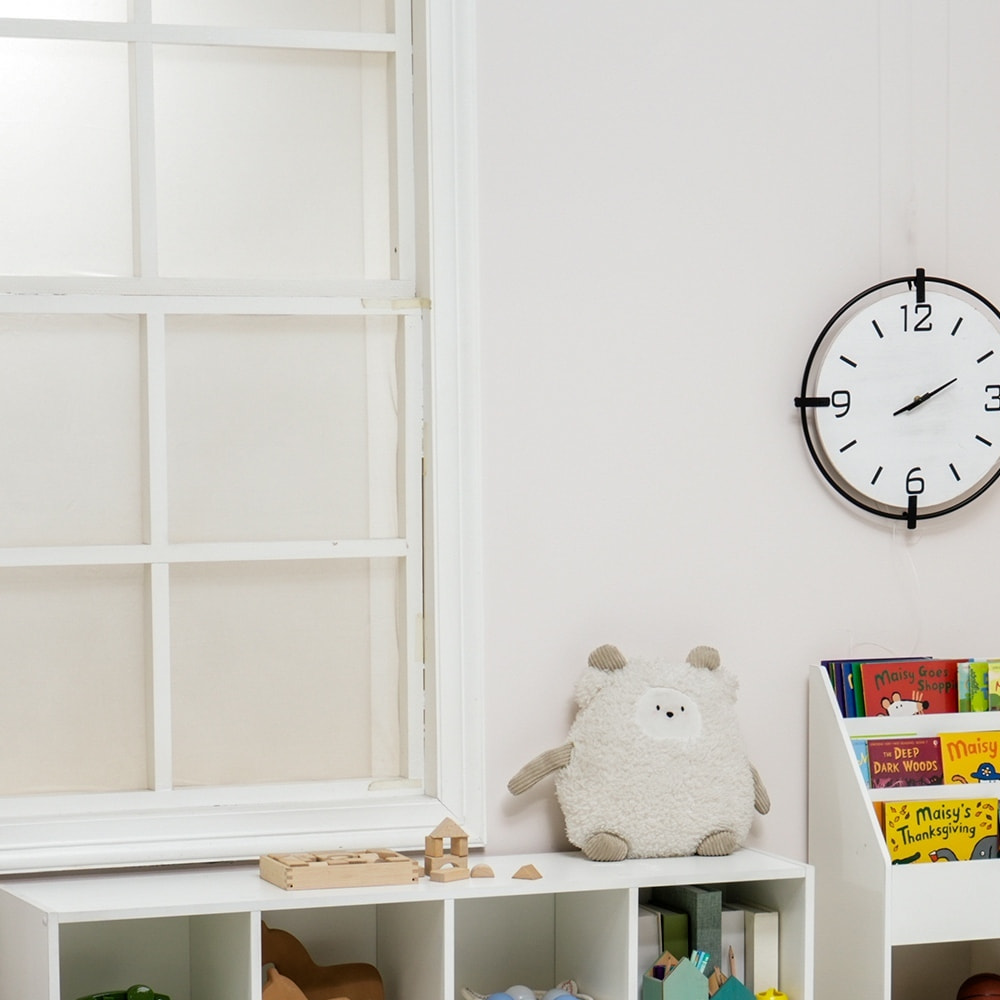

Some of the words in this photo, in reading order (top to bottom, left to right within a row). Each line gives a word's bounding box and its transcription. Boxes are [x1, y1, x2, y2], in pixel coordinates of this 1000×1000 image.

[900, 303, 933, 332] 12
[831, 390, 851, 418] 9
[906, 467, 925, 495] 6
[875, 668, 915, 690] Maisy
[918, 665, 949, 677] Goes
[894, 746, 919, 760] DEEP
[946, 737, 997, 762] Maisy
[873, 761, 899, 774] DARK
[902, 760, 938, 772] WOODS
[916, 803, 971, 825] Maisy's
[896, 822, 976, 845] Thanksgiving
